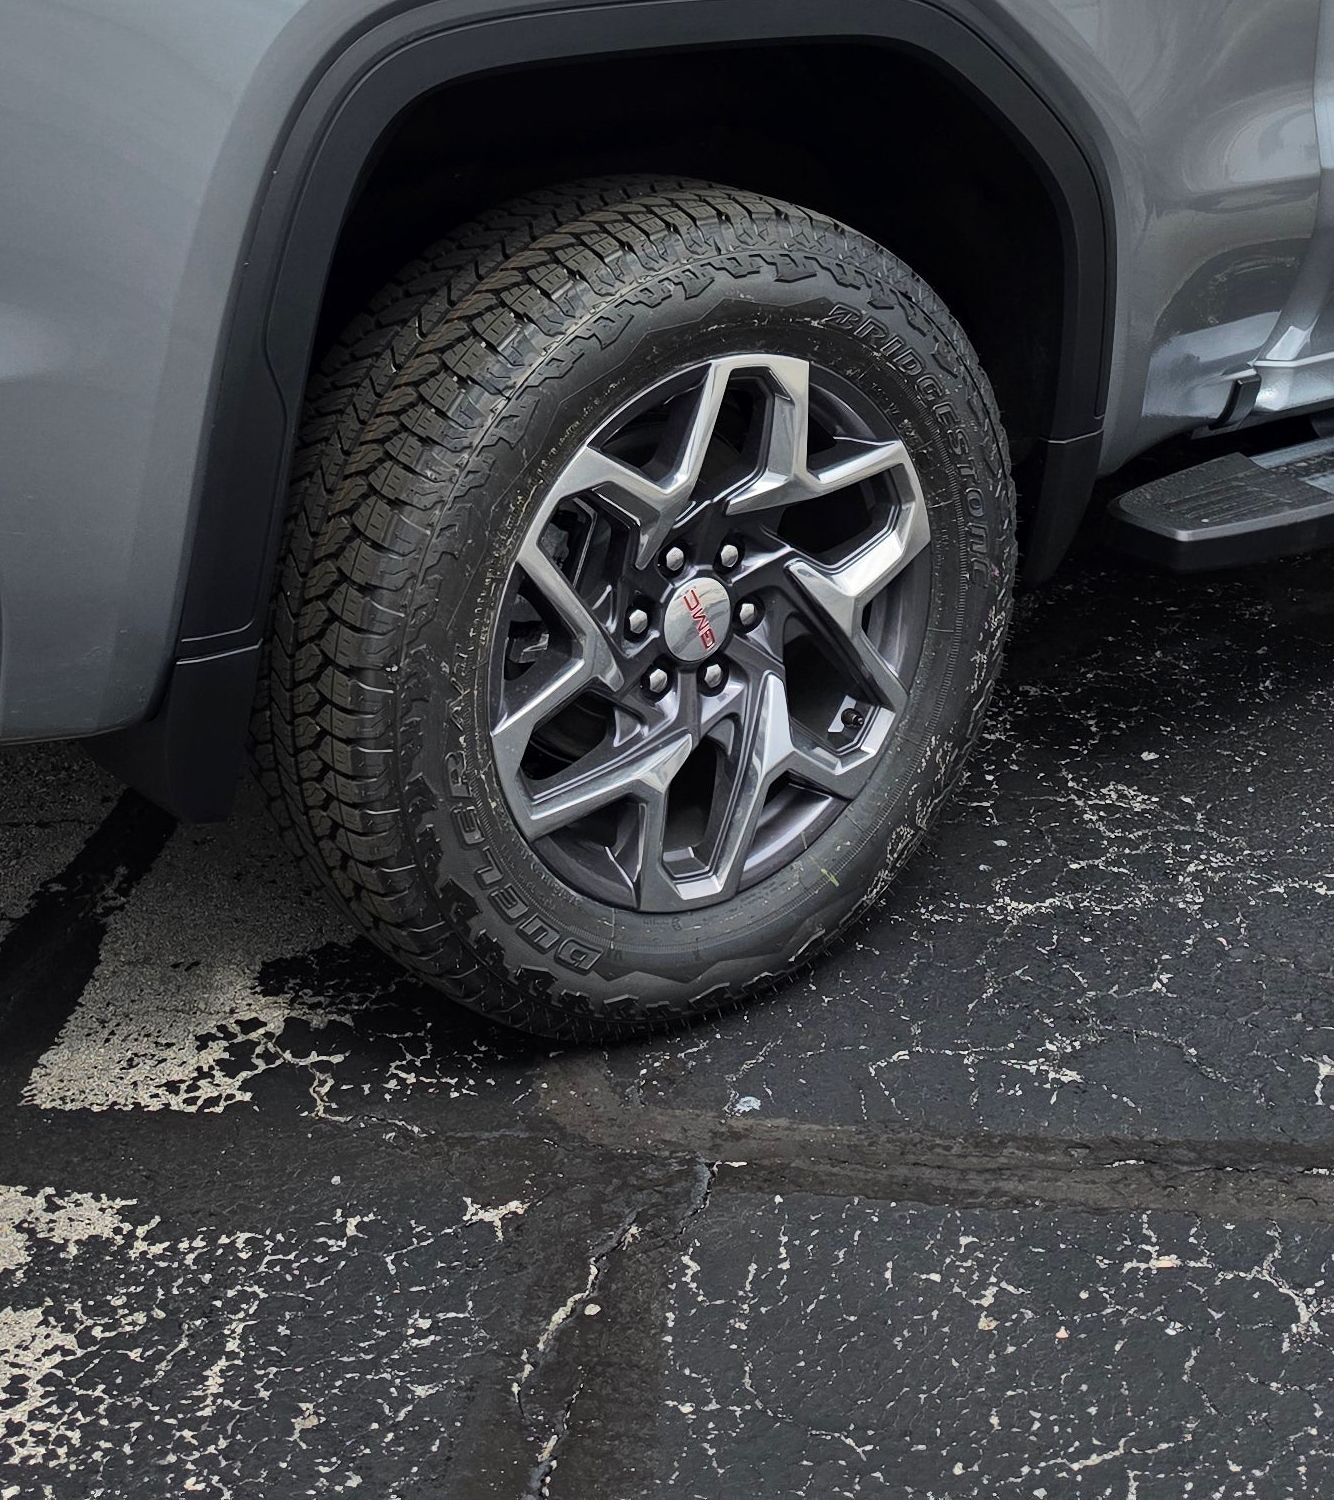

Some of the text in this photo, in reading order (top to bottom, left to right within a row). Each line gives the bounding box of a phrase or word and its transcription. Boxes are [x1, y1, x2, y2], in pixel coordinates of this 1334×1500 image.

[828, 303, 990, 588] BRIDGESTONE
[683, 588, 716, 650] GMC
[445, 750, 603, 976] DUELER
